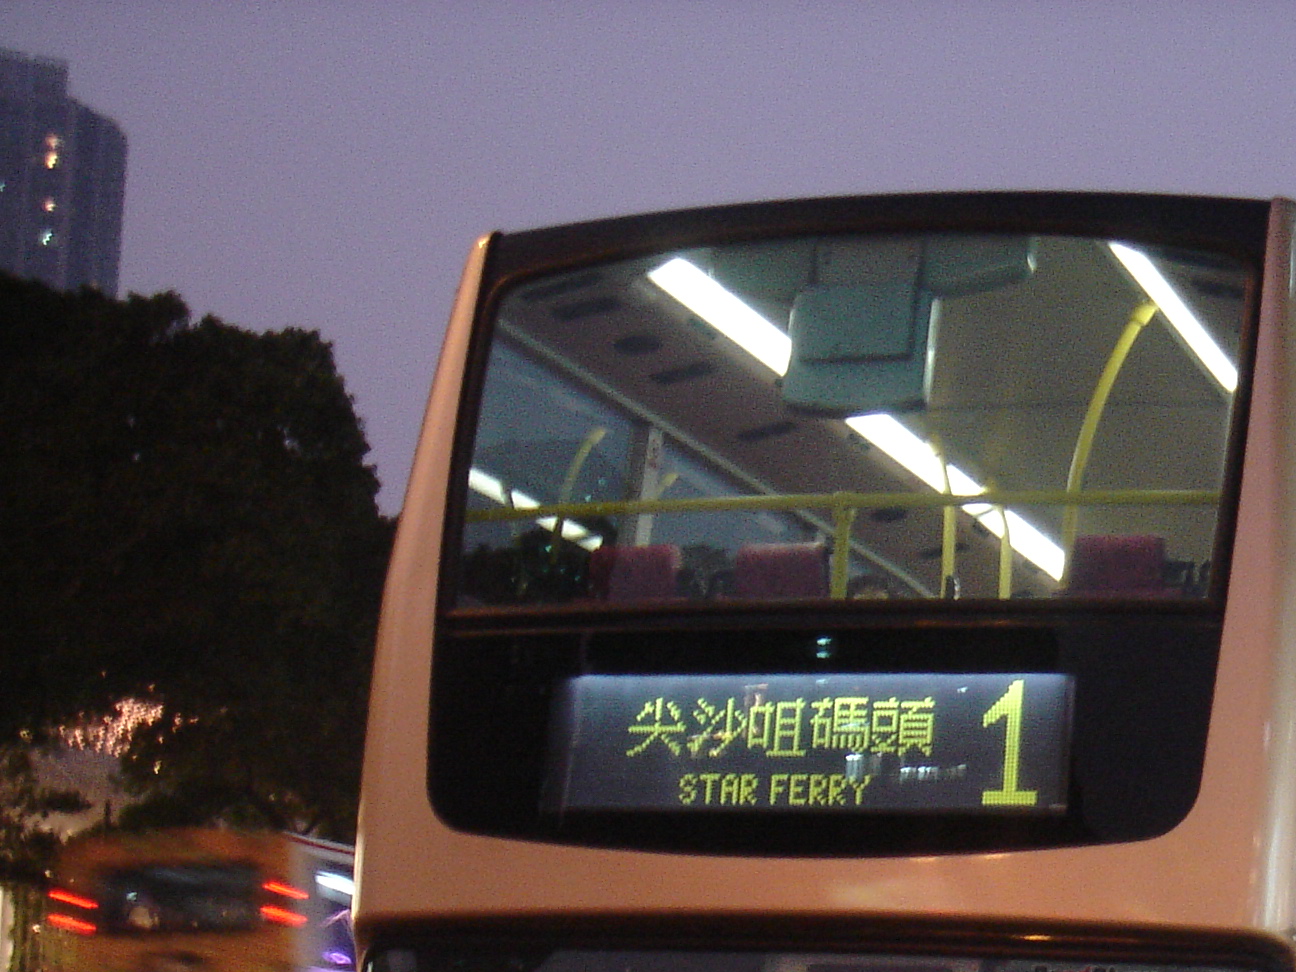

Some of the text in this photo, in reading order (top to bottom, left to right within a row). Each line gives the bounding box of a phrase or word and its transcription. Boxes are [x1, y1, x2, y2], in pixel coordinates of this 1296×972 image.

[626, 696, 936, 758] 尖沙咀碼頭
[982, 680, 1037, 806] 1
[678, 773, 871, 806] STAR FERRY
